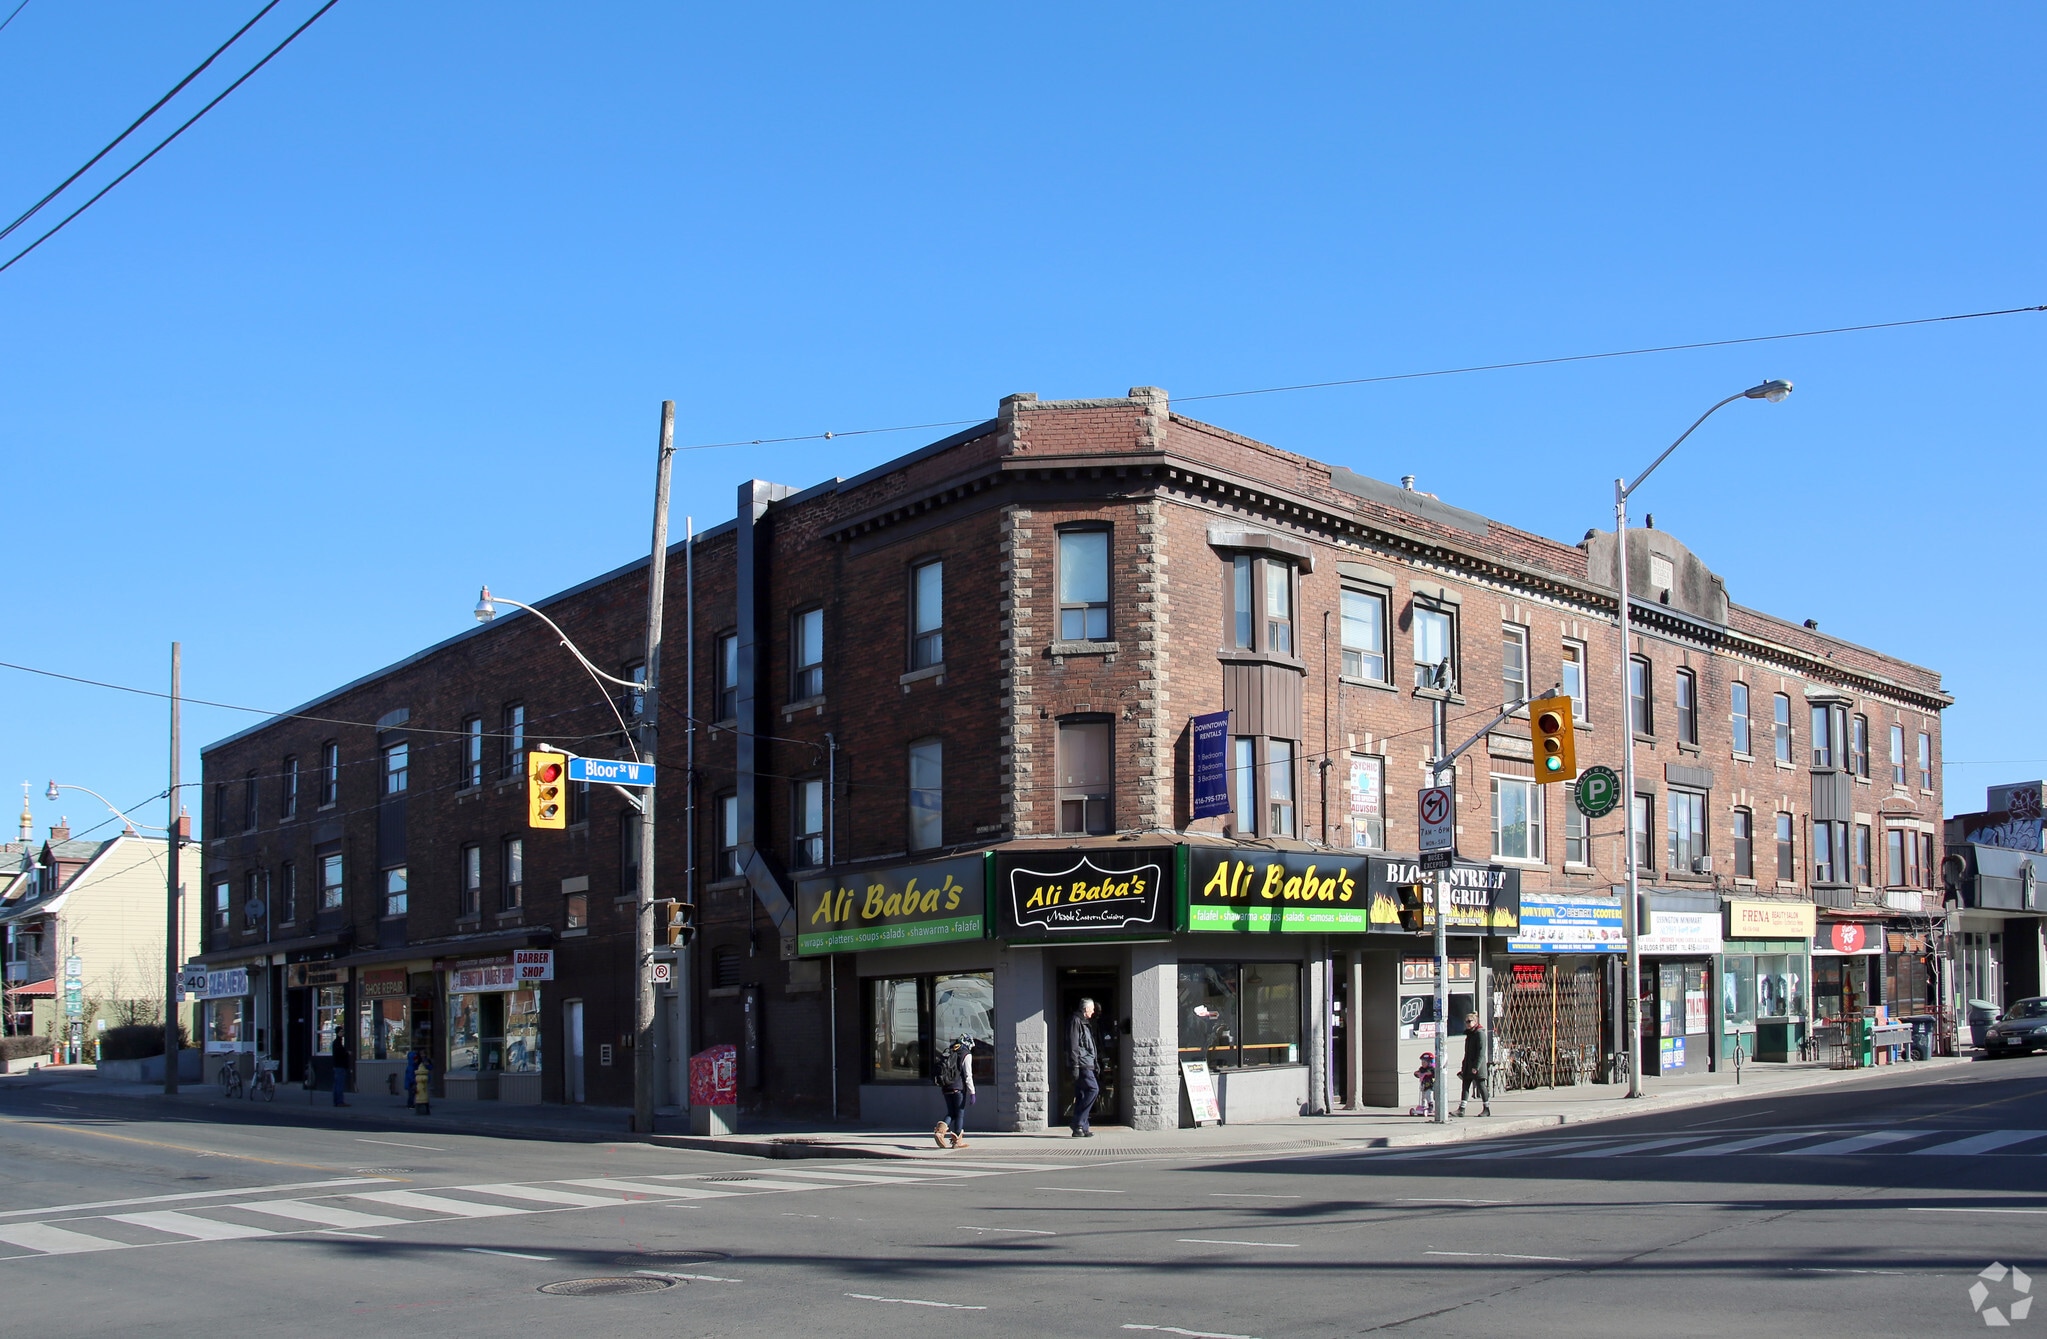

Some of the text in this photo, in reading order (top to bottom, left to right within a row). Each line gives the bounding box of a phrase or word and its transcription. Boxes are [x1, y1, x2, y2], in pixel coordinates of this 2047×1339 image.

[1195, 720, 1228, 732] DOWNTOWN
[1200, 730, 1222, 740] RENTALS
[1202, 751, 1224, 761] Bedroom
[585, 760, 639, 780] Bloor St W
[1202, 763, 1224, 771] Bedroom
[1351, 760, 1378, 772] PSYCHIC
[1202, 773, 1223, 782] Bedroom
[1576, 768, 1618, 793] MUNICIPAL
[1589, 779, 1606, 800] P
[1351, 803, 1378, 814] ADVISOR
[1577, 794, 1618, 816] PARKING
[1421, 828, 1432, 837] 7AM
[1438, 826, 1450, 834] 6PM
[1427, 853, 1444, 861] BUSES
[1424, 859, 1449, 869] EXCEPTED
[1204, 860, 1255, 897] Ali
[1261, 863, 1356, 902] Baba's
[1450, 869, 1507, 889] STREET
[1026, 875, 1146, 909] Ali Baba's
[1451, 888, 1490, 906] GRILL
[812, 875, 963, 925] Ali Baba's
[1047, 909, 1124, 922] Middle Eastern Cuisine
[1197, 910, 1362, 923] falafel shawarma soups salads samosas baklawa
[1520, 907, 1555, 917] DOWNTOWN
[1742, 909, 1770, 923] FRENA
[1771, 911, 1799, 919] BEAUTY SALON
[1656, 916, 1702, 924] OSSINGTON MINIMART
[804, 920, 980, 948] wraps platters soups salads shawarma falafel
[517, 952, 548, 964] BARBER
[522, 966, 544, 978] SHOP
[187, 976, 205, 988] 40
[365, 981, 404, 995] SHOE REPAIR
[1401, 1000, 1422, 1020] OPEN
